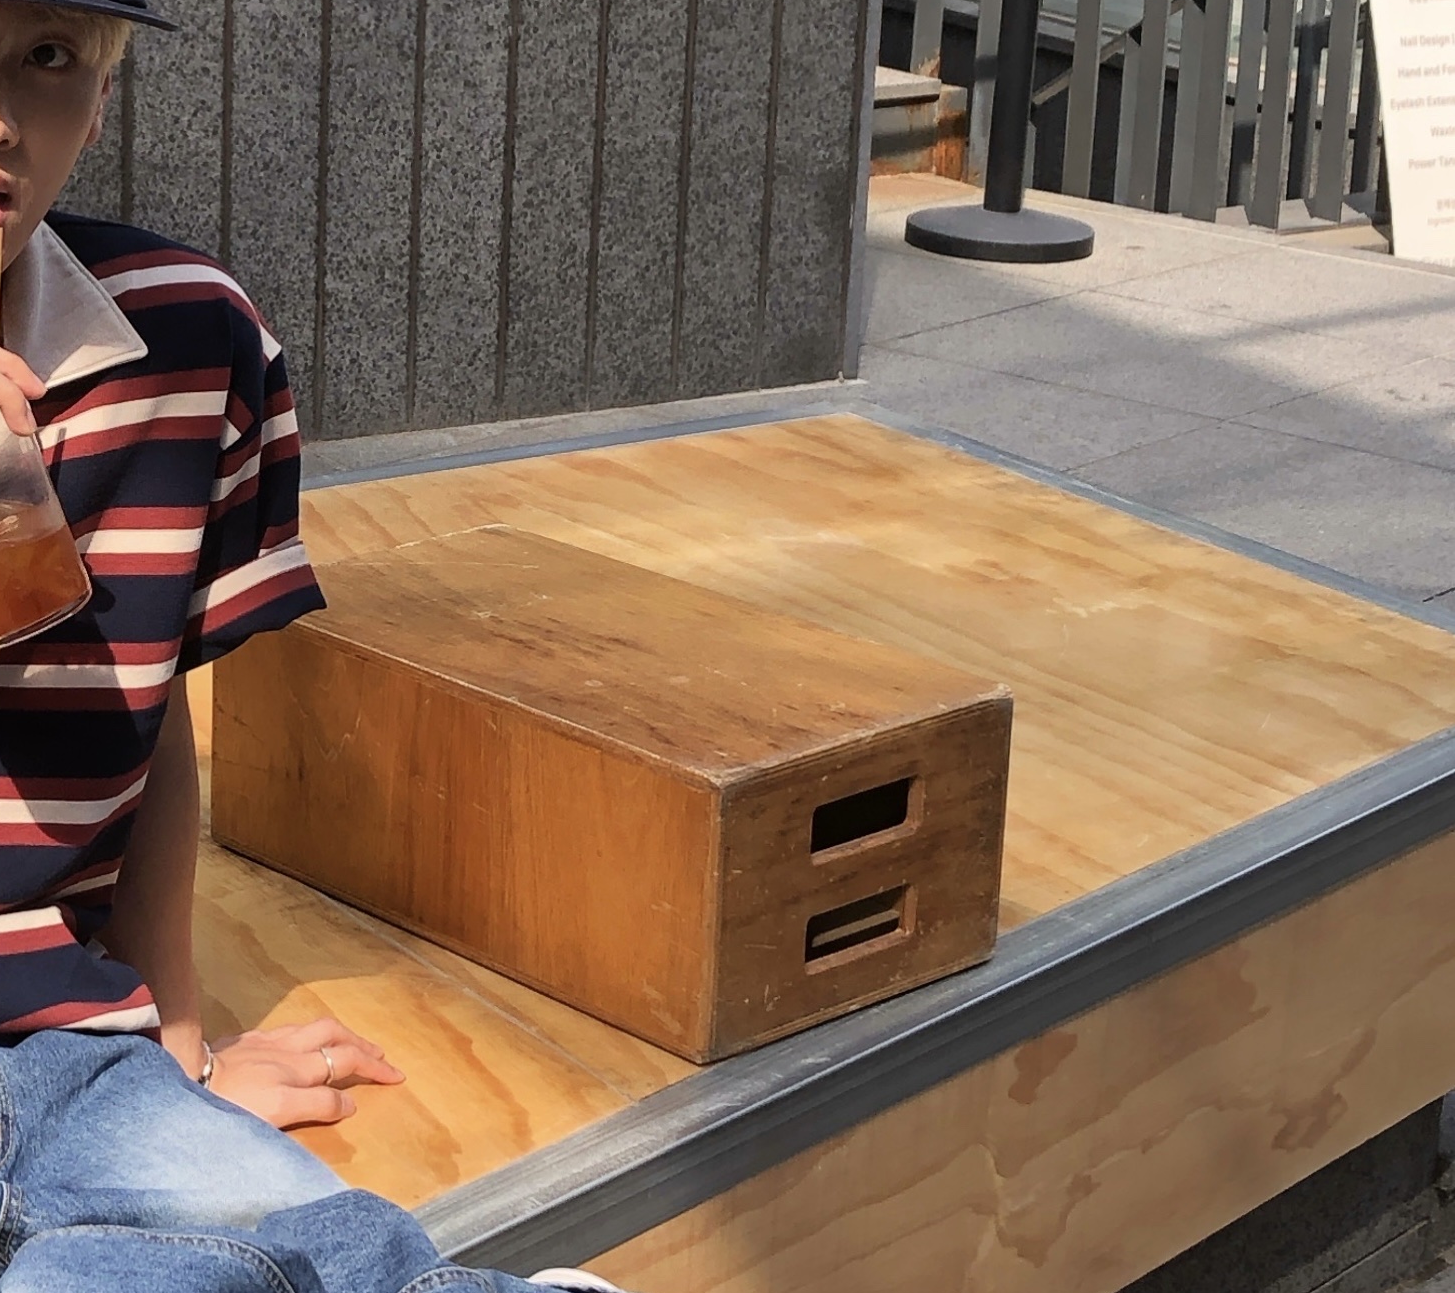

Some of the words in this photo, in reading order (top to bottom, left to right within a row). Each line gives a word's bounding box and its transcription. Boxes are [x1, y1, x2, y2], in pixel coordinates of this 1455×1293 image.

[1400, 35, 1418, 47] Nail
[1419, 34, 1450, 48] Design
[1397, 66, 1422, 78] Hand
[1423, 65, 1440, 77] and
